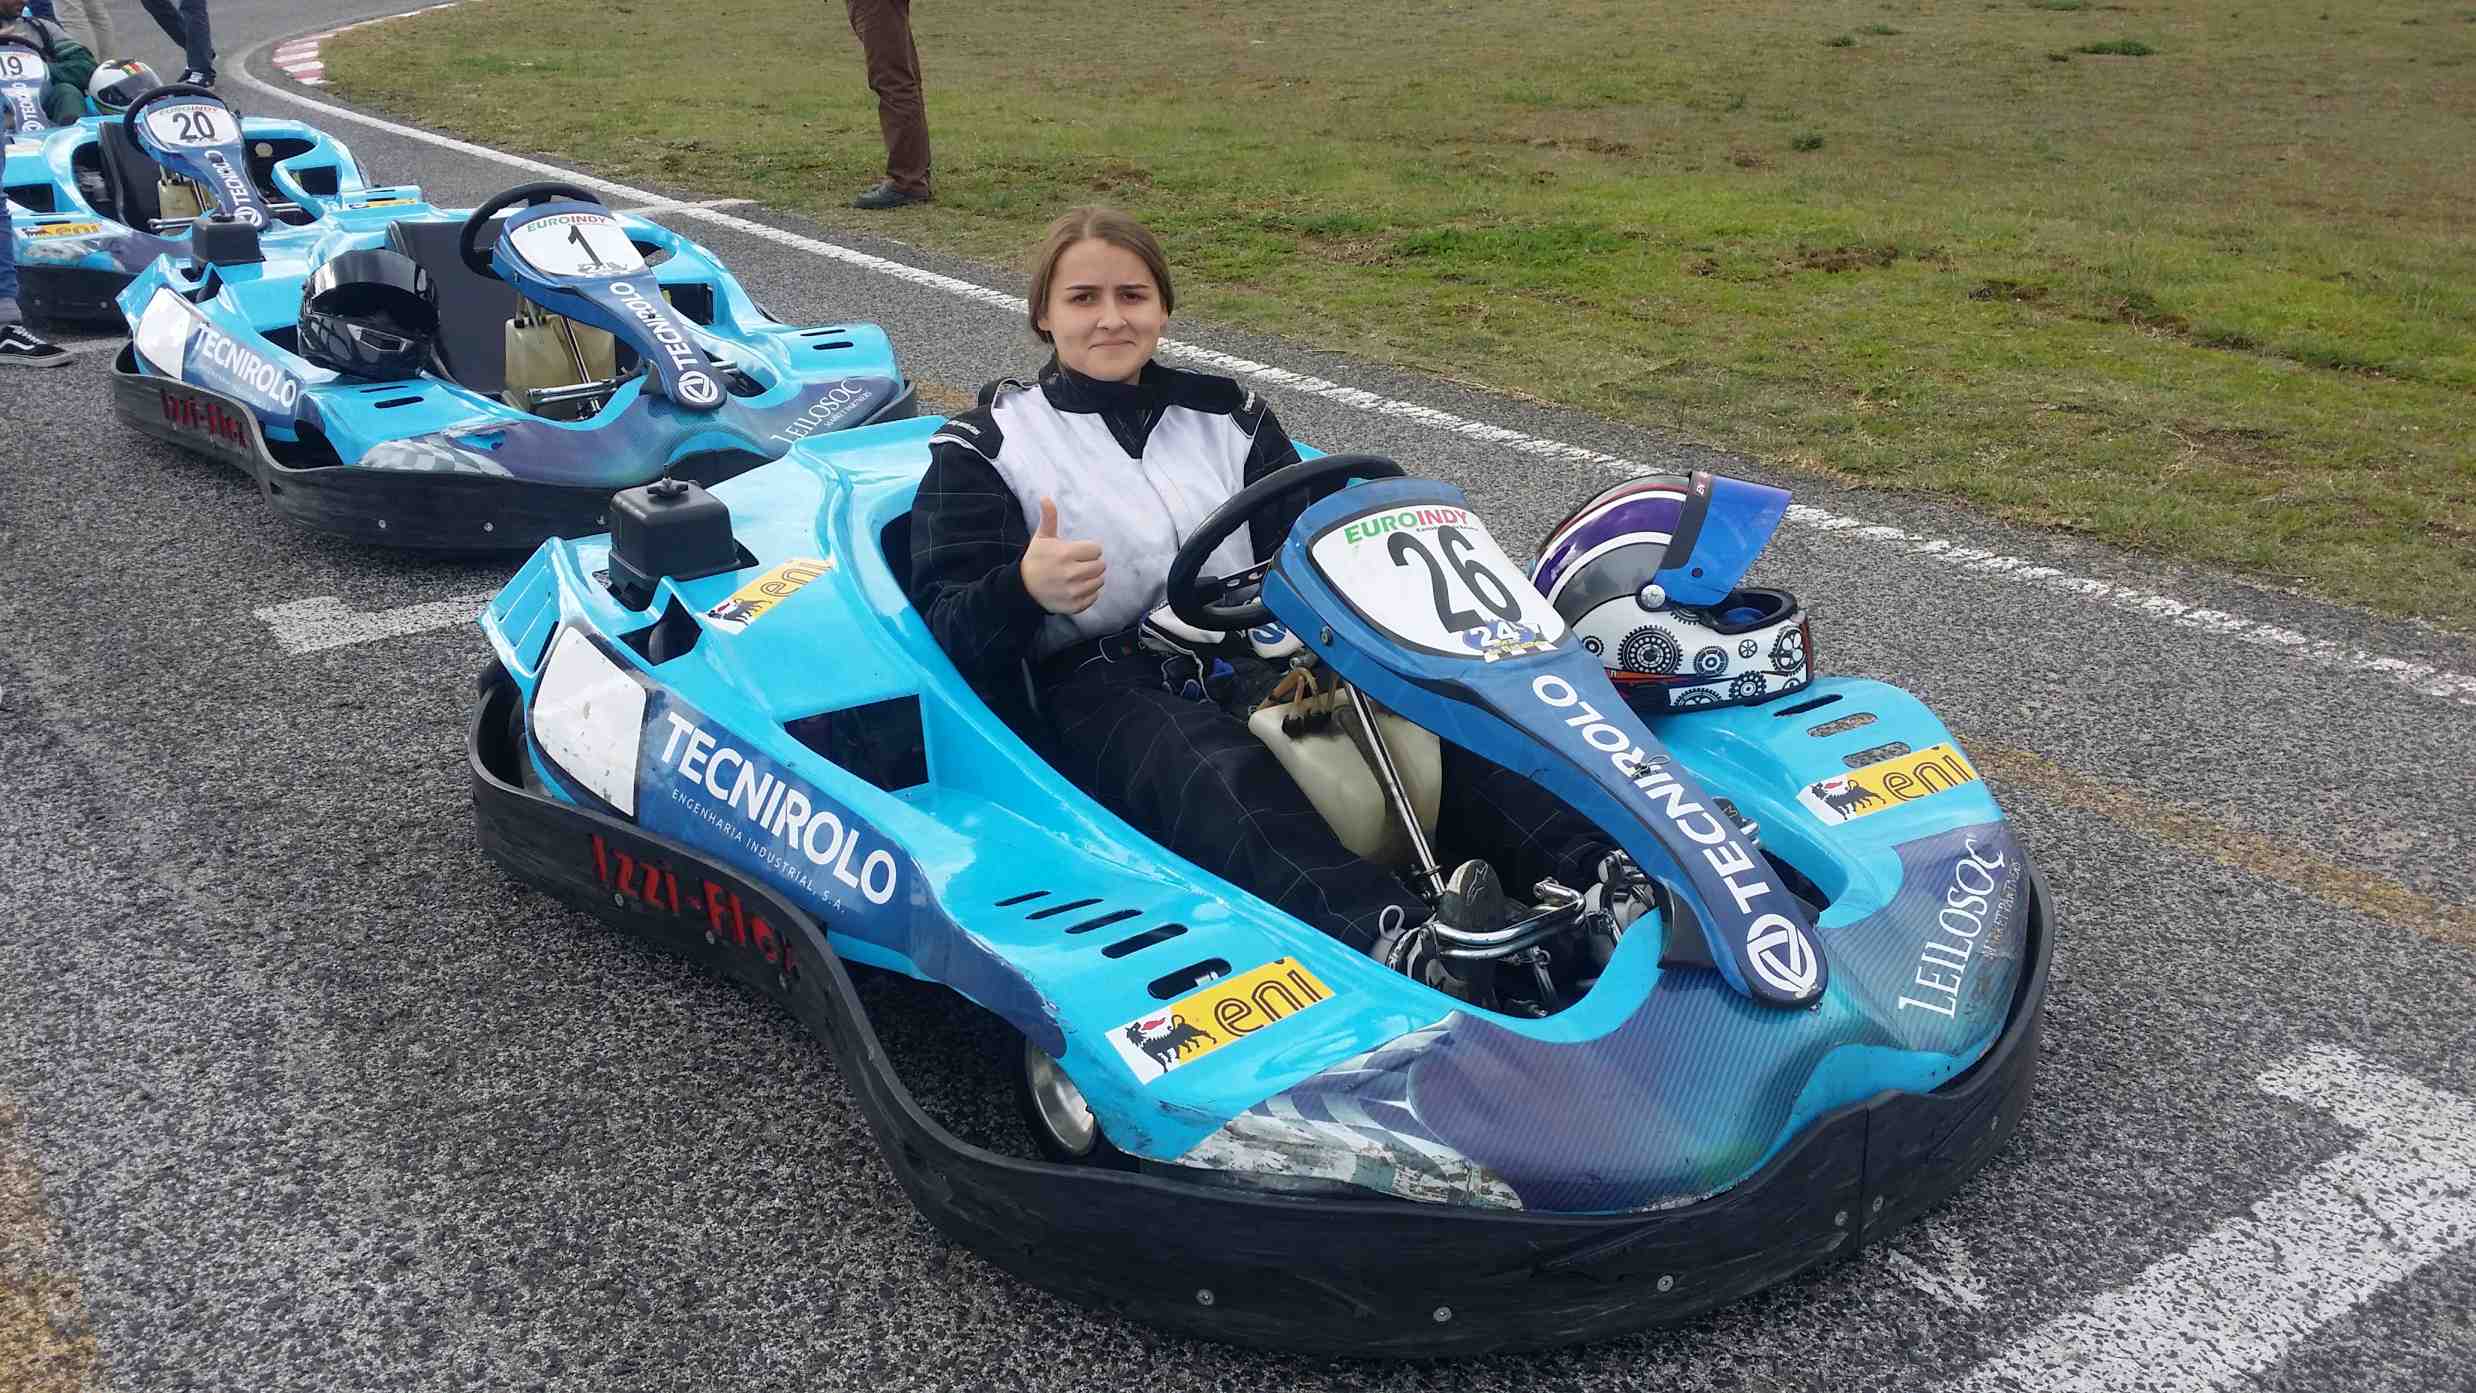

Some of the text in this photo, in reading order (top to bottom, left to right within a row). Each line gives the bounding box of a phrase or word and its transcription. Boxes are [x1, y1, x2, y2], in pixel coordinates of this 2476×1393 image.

[0, 56, 23, 75] 19
[172, 110, 216, 140] 20
[527, 215, 607, 233] EUROINDY
[567, 224, 602, 267] 1
[191, 321, 297, 408] TECNIROLO
[609, 282, 698, 370] TECNIROLO
[1344, 509, 1467, 544] EUROINDY
[760, 560, 832, 598] eni
[1387, 525, 1522, 634] 26
[661, 711, 897, 905] TECNIROLO
[1532, 674, 1771, 914] TECNIROLO
[1883, 746, 1973, 801] eni
[671, 787, 846, 913] ENGENHARIA INDUSTRIAL, S.A.
[1898, 836, 2005, 1018] LEILOSOC
[1214, 958, 1323, 1037] eni
